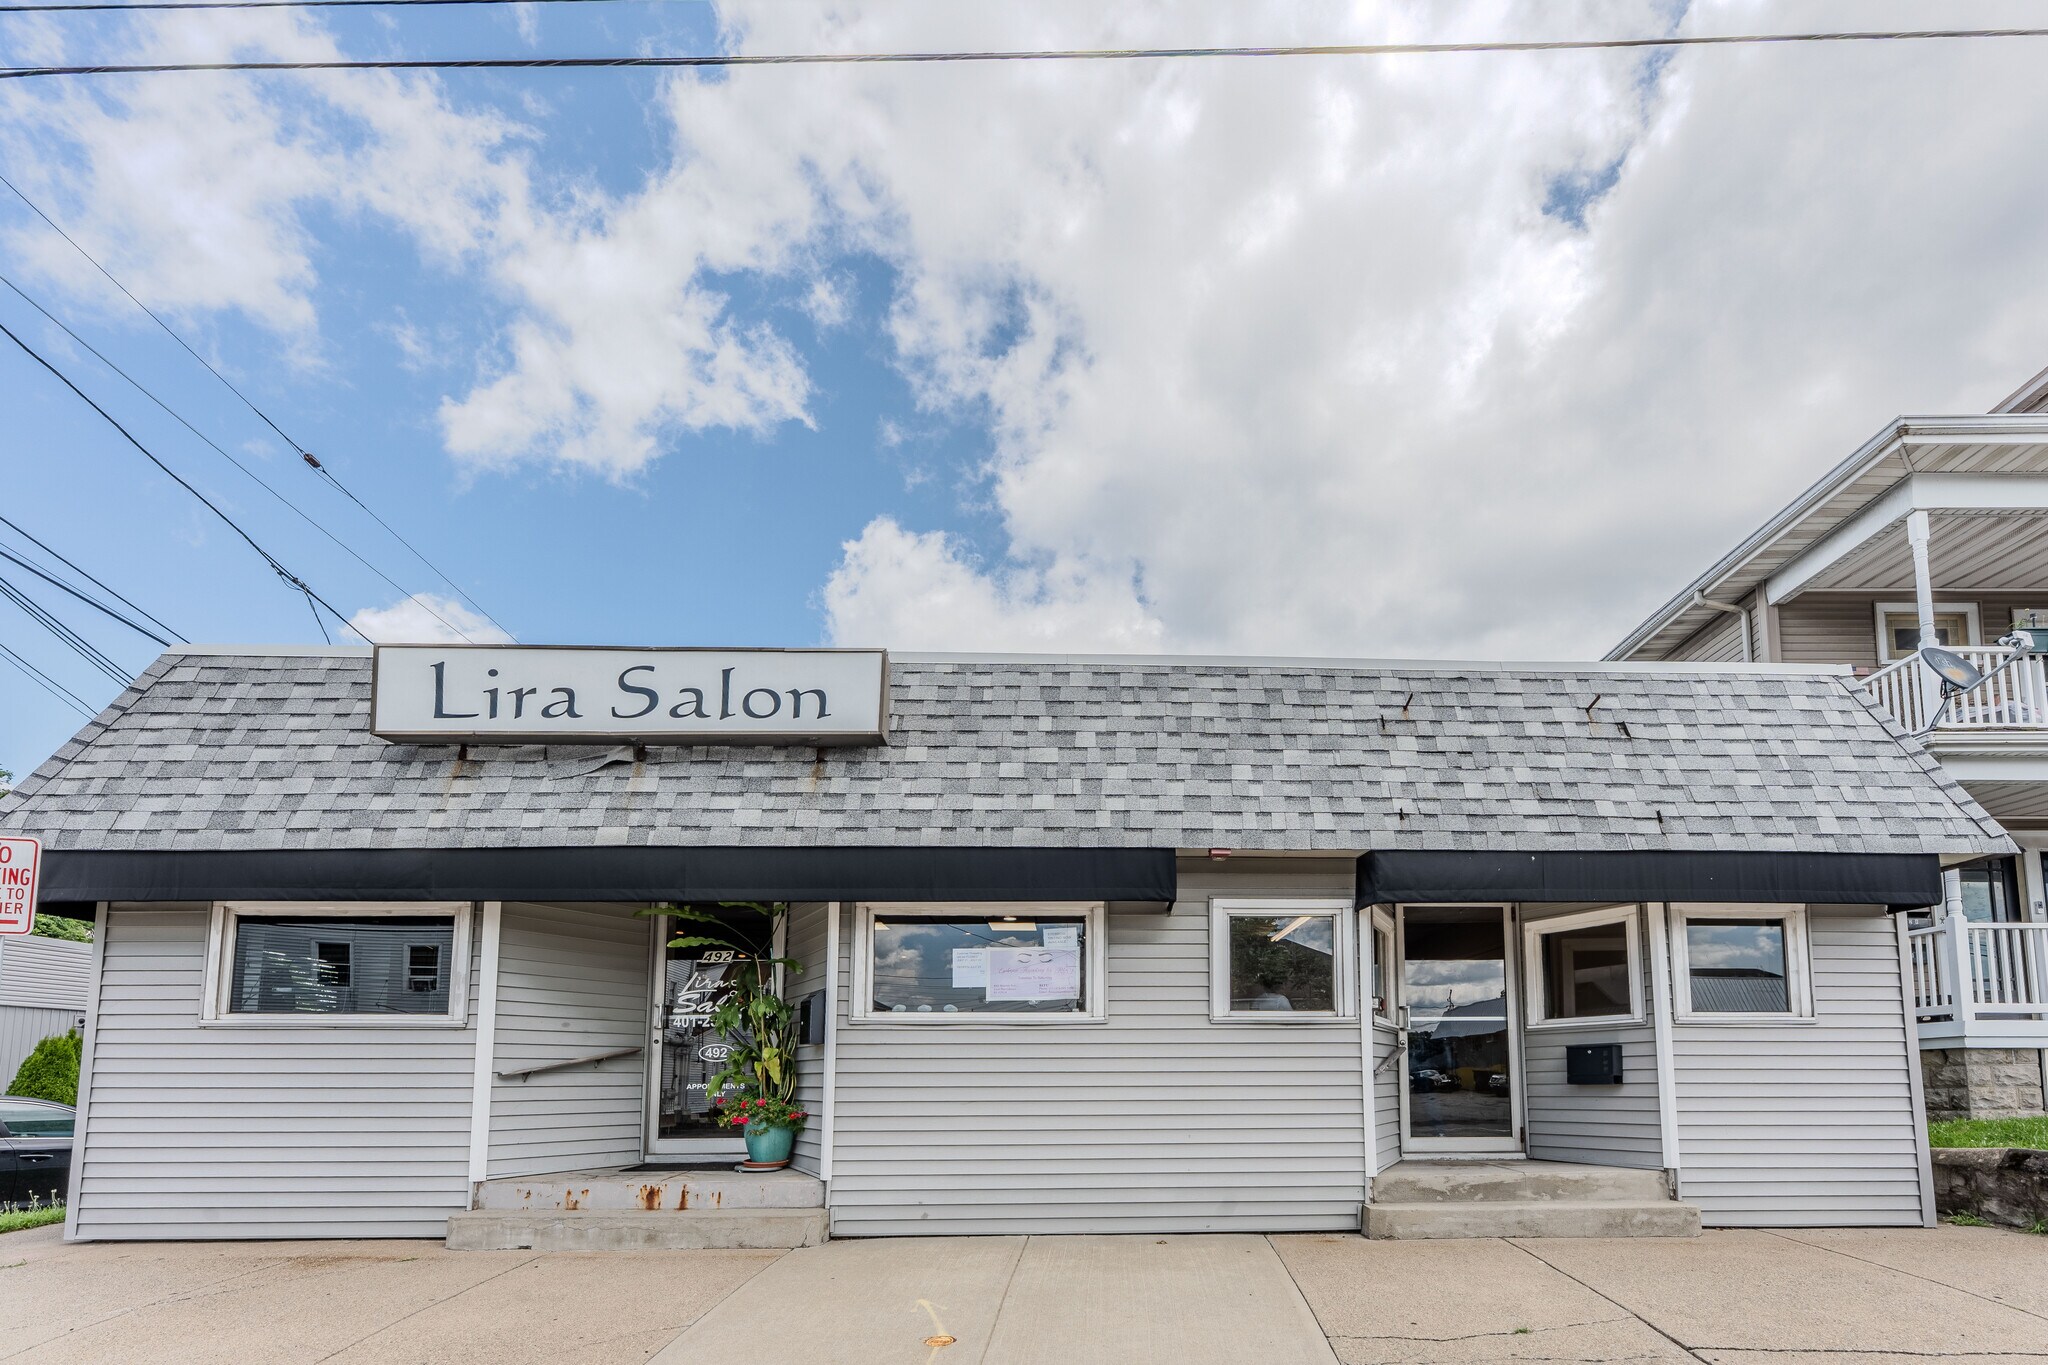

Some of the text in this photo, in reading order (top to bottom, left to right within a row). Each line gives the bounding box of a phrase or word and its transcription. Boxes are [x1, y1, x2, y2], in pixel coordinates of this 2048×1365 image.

[429, 661, 832, 721] Lira Salon
[7, 887, 25, 900] TO
[703, 951, 732, 962] 492
[704, 1047, 728, 1059] 492
